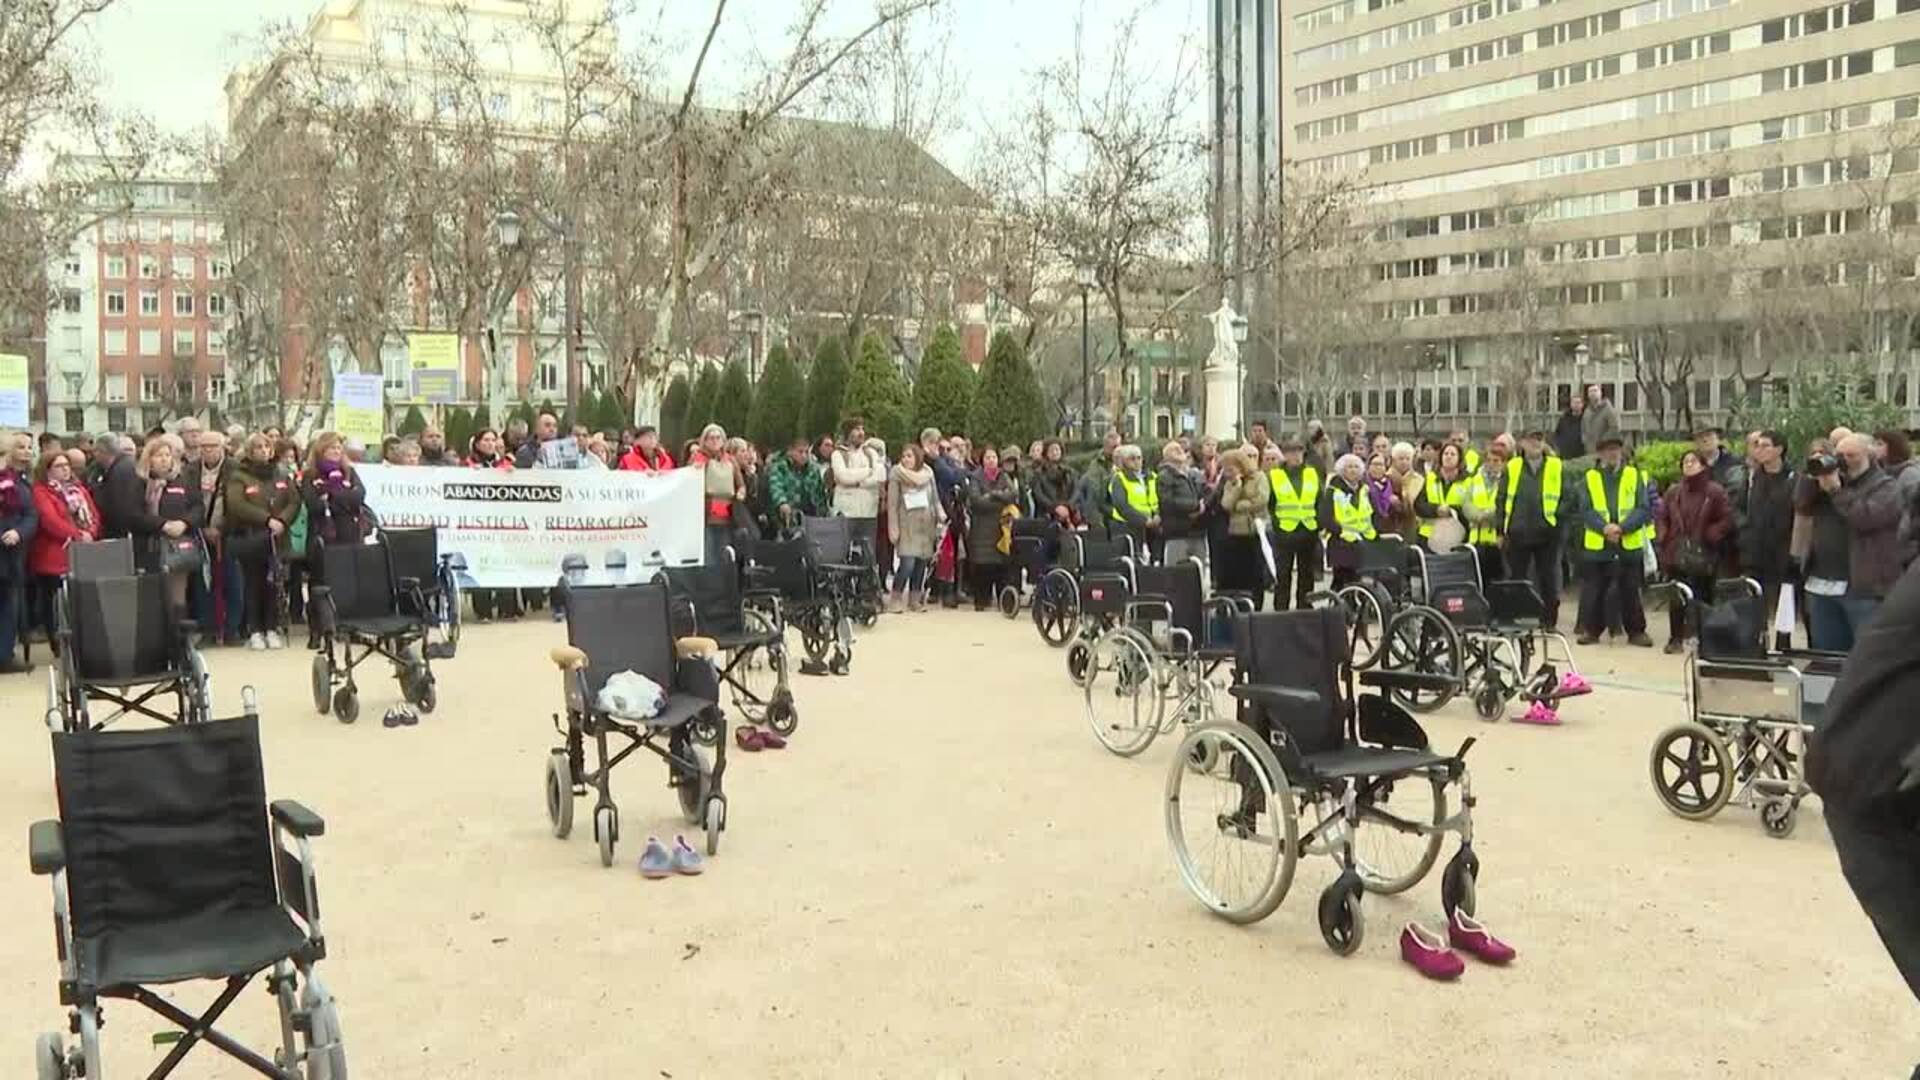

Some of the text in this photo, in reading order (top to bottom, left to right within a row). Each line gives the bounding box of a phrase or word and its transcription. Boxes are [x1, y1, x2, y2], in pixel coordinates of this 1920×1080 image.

[444, 485, 561, 501] ABANDONADAS
[380, 512, 450, 528] VERDAD
[457, 514, 528, 530] JUSTICIA
[545, 512, 648, 530] REPARACIÓN
